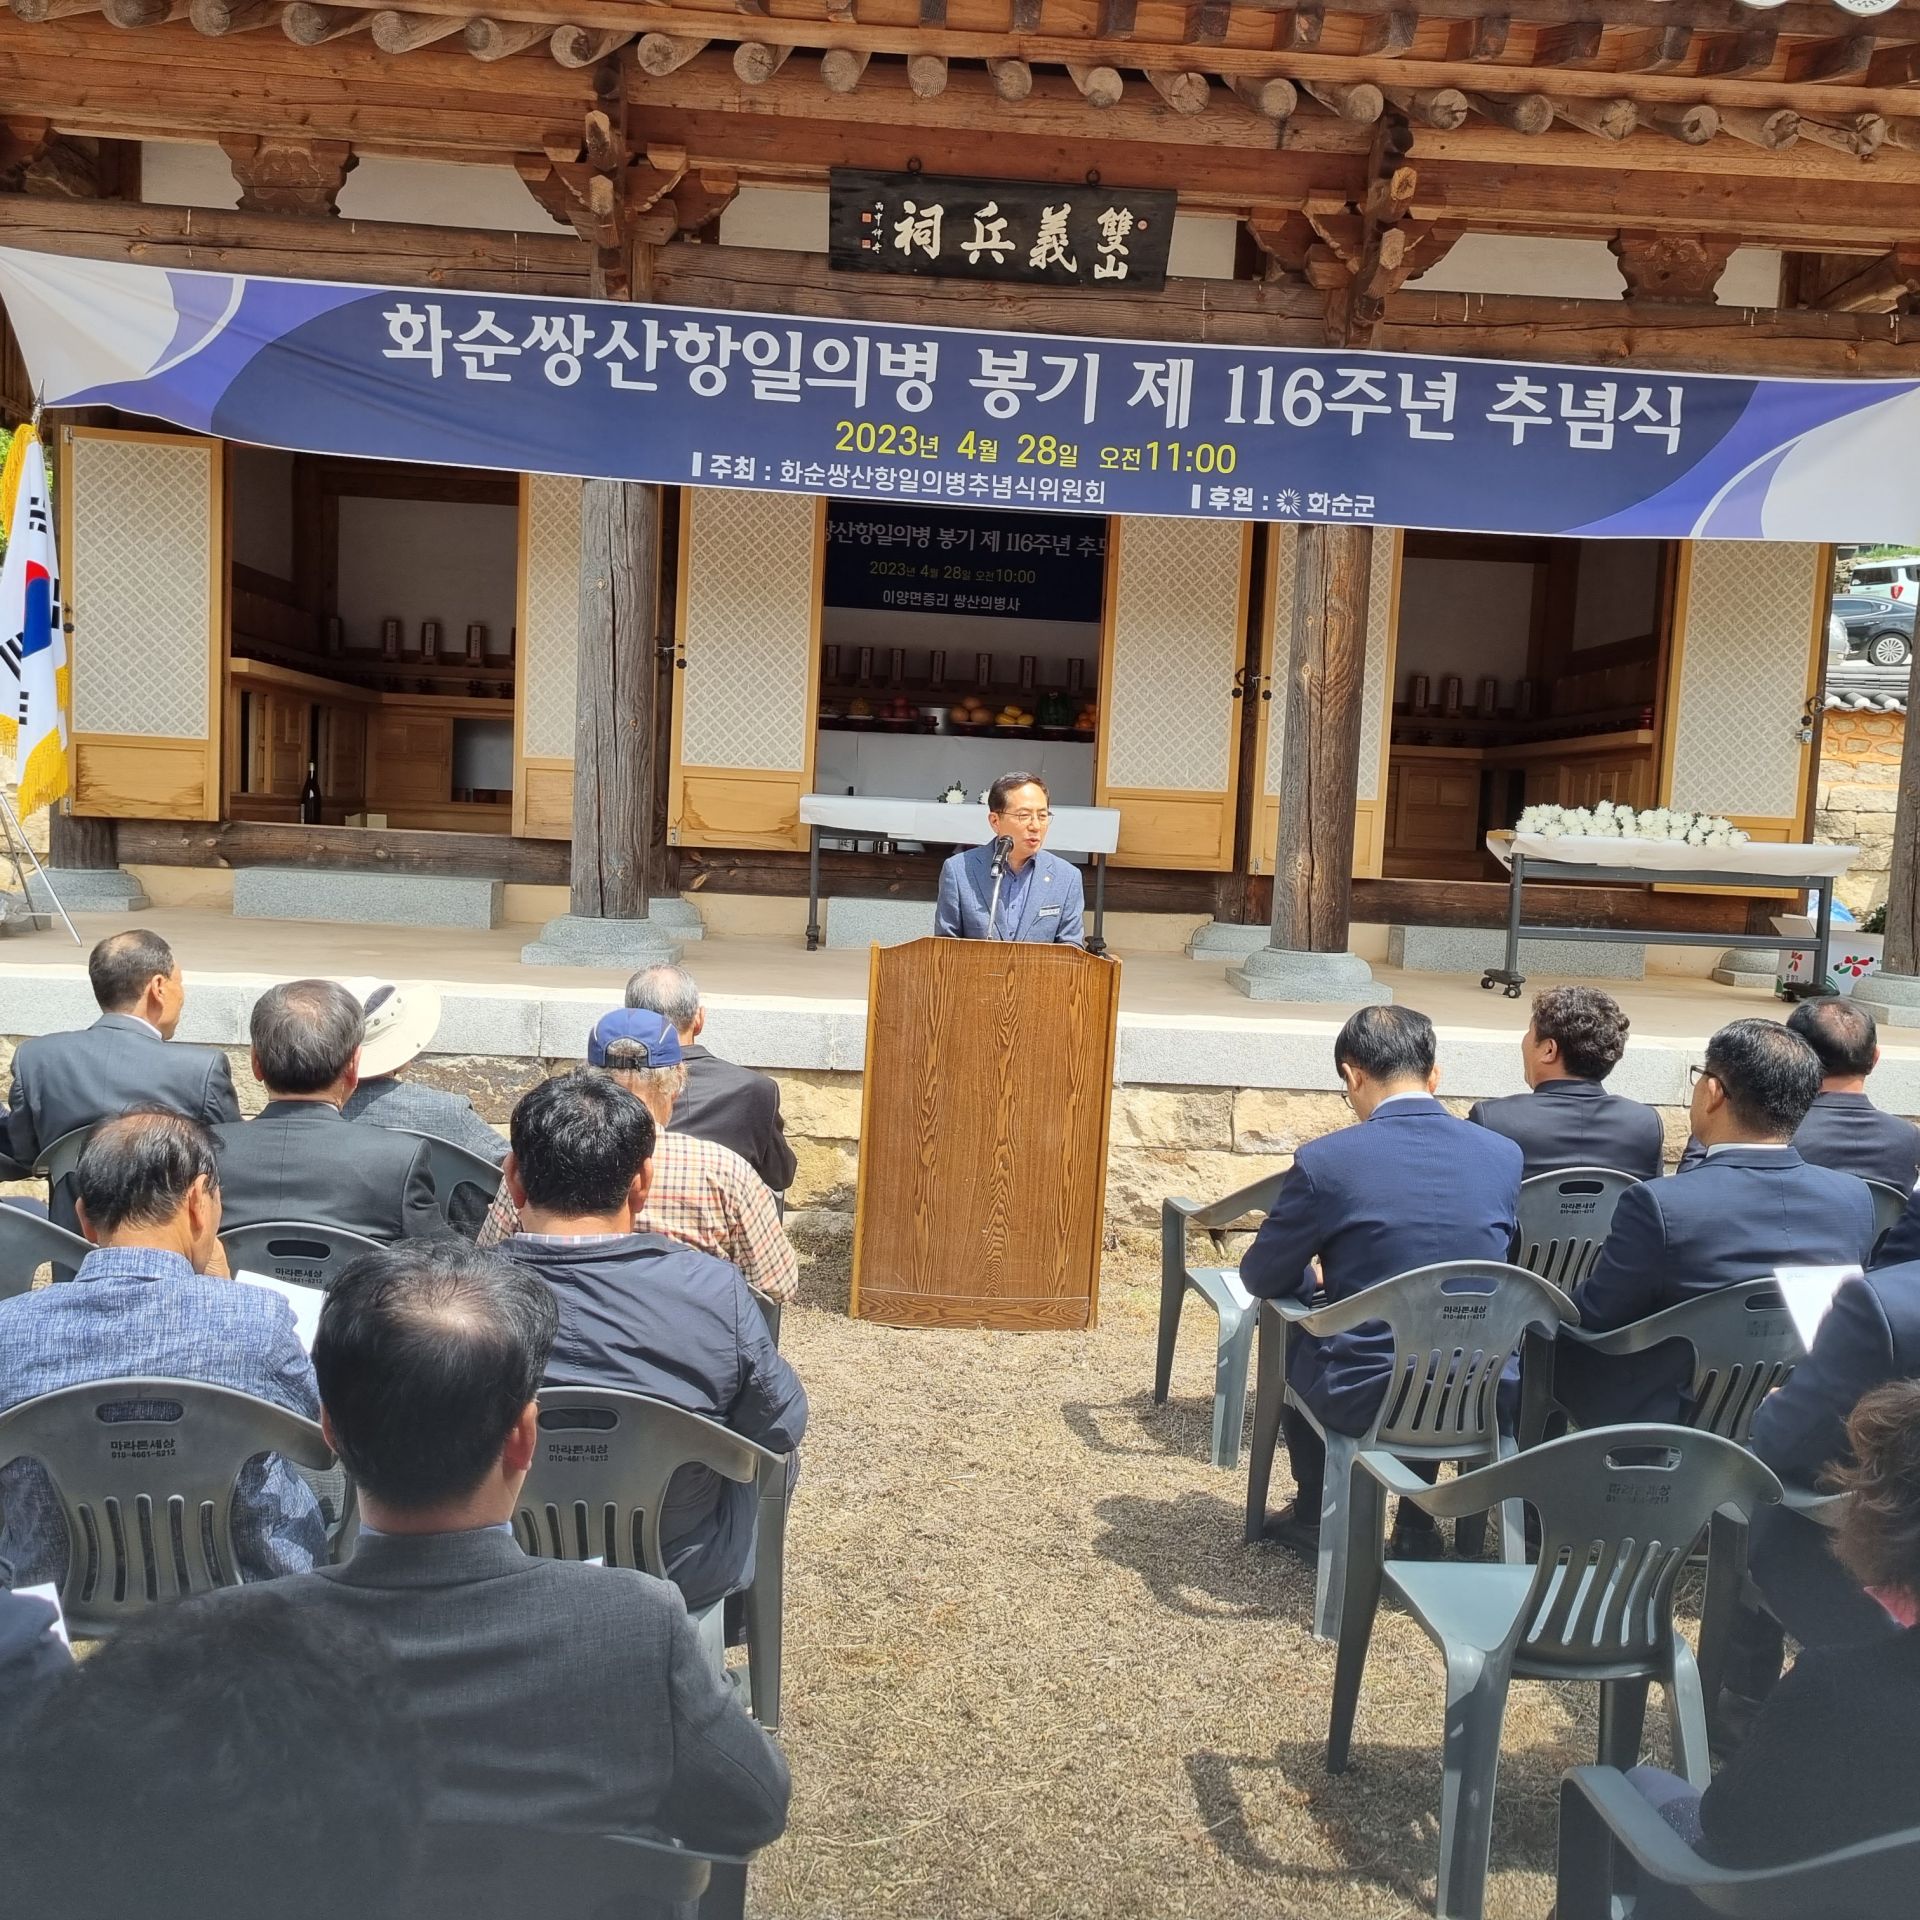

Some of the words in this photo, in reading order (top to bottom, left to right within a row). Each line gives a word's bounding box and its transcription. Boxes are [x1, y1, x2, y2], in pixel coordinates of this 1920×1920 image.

[382, 303, 939, 413] 화순쌍산항일의병
[968, 348, 1100, 425] 봉기
[1126, 358, 1194, 430] 제
[1224, 364, 1457, 441] 116주년
[1485, 375, 1682, 455] 추념식
[835, 420, 939, 460] 2023년
[957, 430, 998, 463] 4월
[1017, 433, 1078, 468] 28일
[779, 459, 1105, 505] 화순쌍산항일의병추념식위원회
[1306, 492, 1375, 518] 화순군
[936, 527, 975, 551] 봉기
[980, 530, 1000, 553] 제
[1006, 533, 1071, 557] 116주년
[869, 560, 916, 578] 2023년
[920, 565, 939, 579] 4월
[943, 565, 971, 581] 28일
[953, 593, 1021, 612] 쌍산의병사
